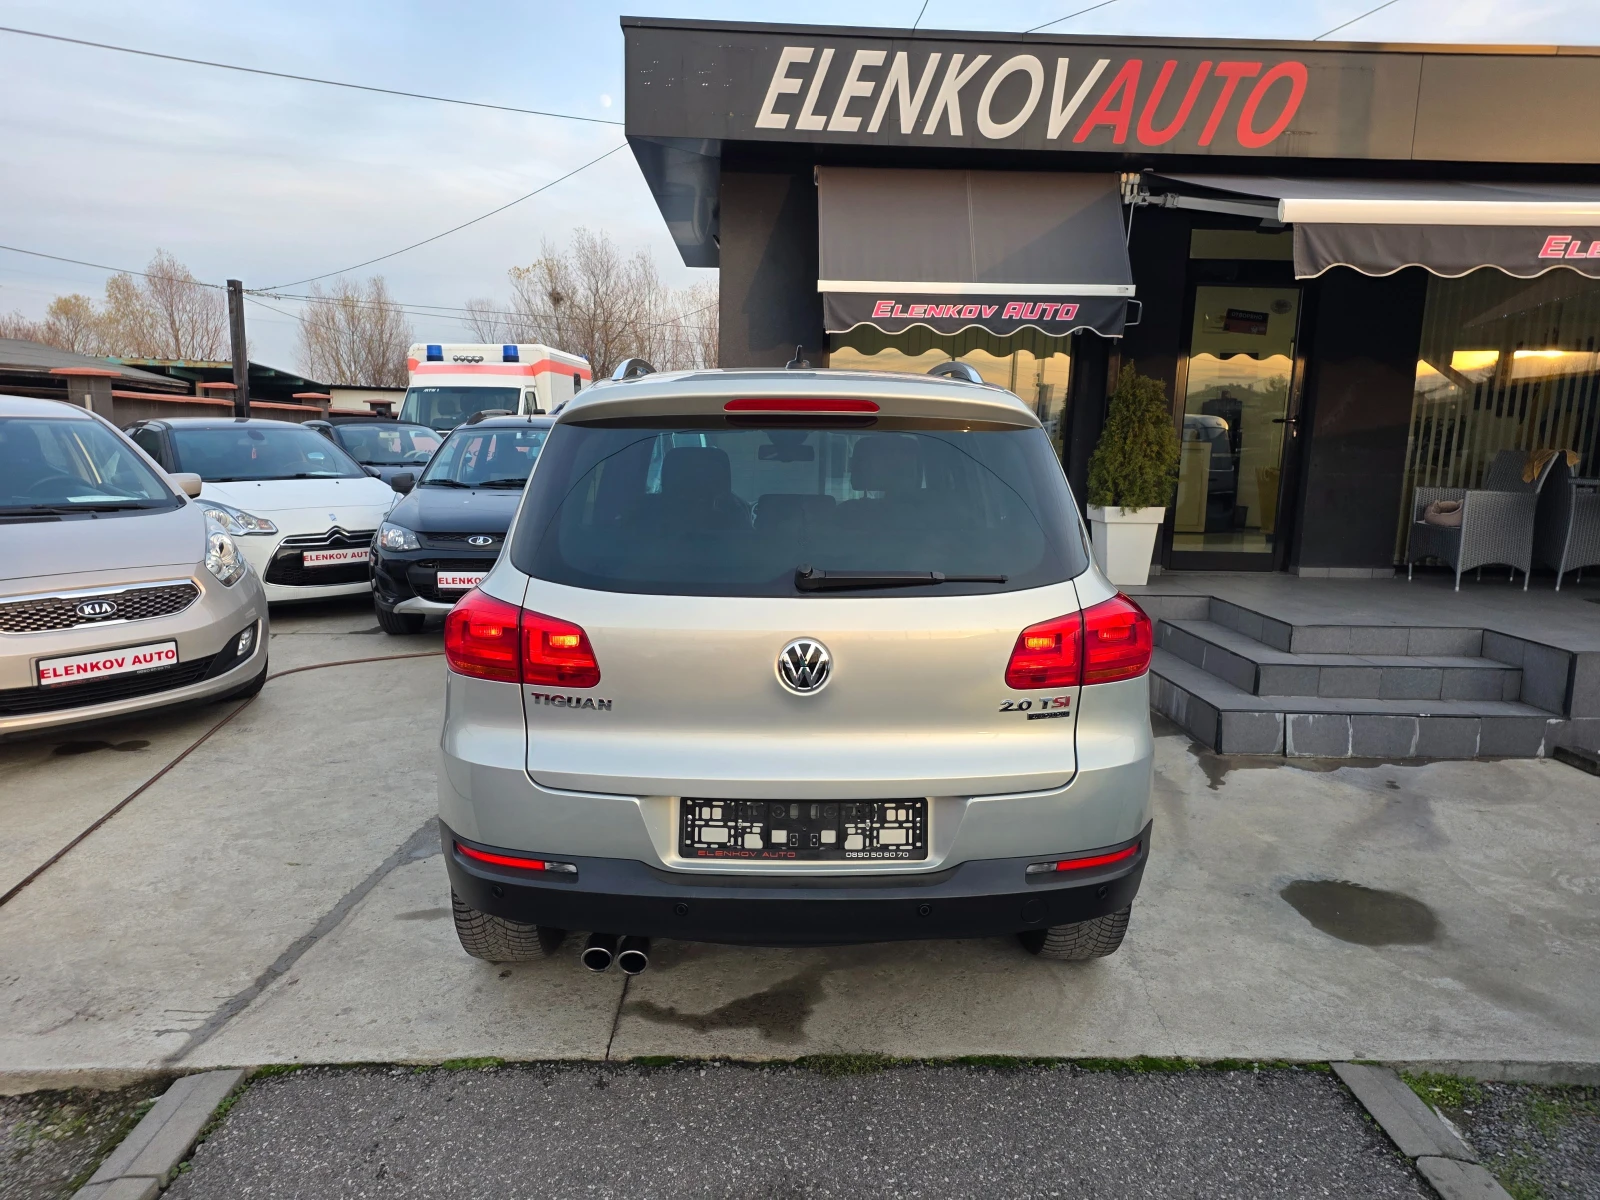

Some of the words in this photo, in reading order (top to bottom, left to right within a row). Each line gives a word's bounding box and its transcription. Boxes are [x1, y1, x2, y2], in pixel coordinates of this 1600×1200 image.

[1001, 301, 1080, 321] AUTO
[303, 552, 348, 562] ELENKOV
[350, 551, 369, 559] AUT
[438, 577, 484, 585] ELENKO
[83, 603, 112, 615] KIA
[40, 656, 126, 680] ELENKOV
[131, 649, 176, 666] AUTO
[531, 692, 612, 711] TIGUAN
[999, 697, 1032, 712] 2.0
[1039, 695, 1071, 709] TSI
